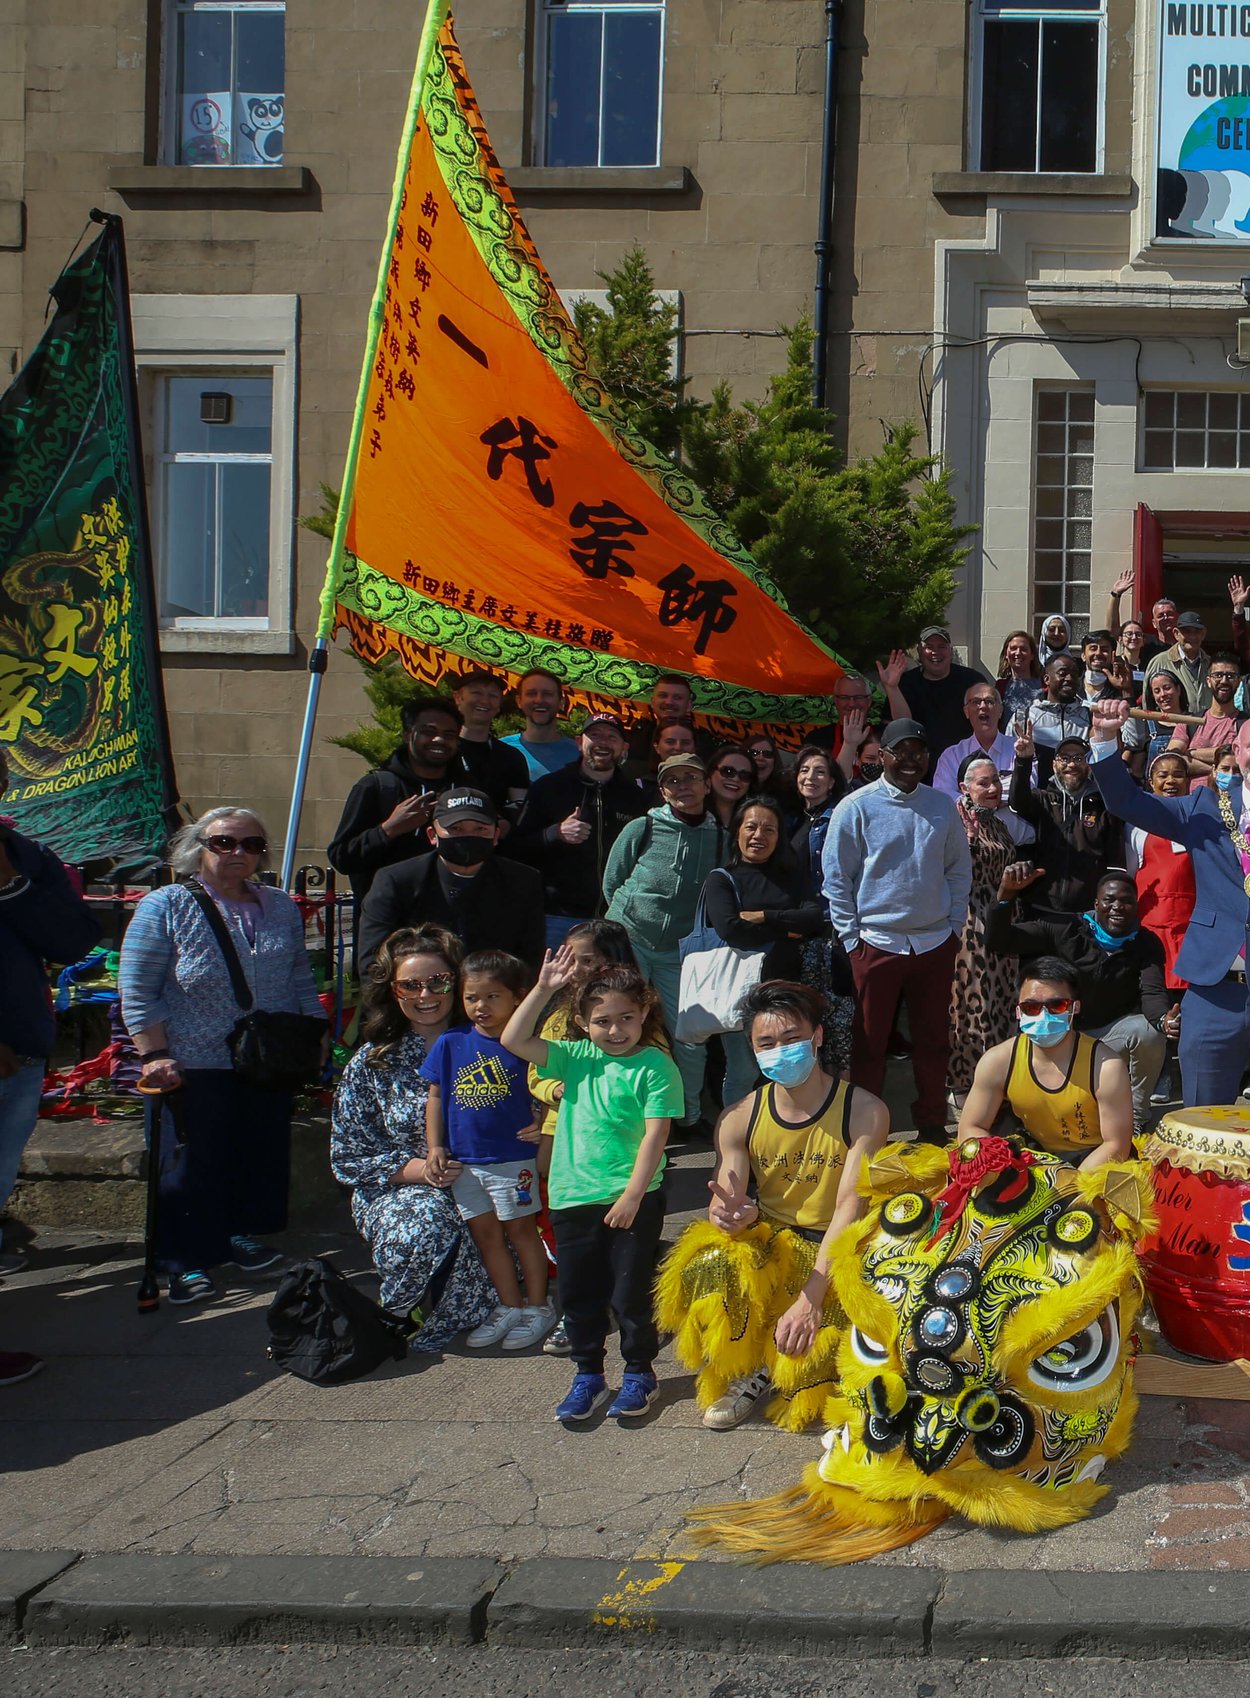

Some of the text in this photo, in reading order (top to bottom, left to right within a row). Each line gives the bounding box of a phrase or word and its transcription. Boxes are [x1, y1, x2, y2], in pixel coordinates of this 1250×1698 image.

[6, 789, 20, 802] &
[22, 768, 87, 800] DRAGON
[447, 796, 483, 809] SCOTLAND
[456, 1084, 508, 1098] adidas
[1152, 1172, 1192, 1211] aster
[1159, 1221, 1221, 1259] Man
